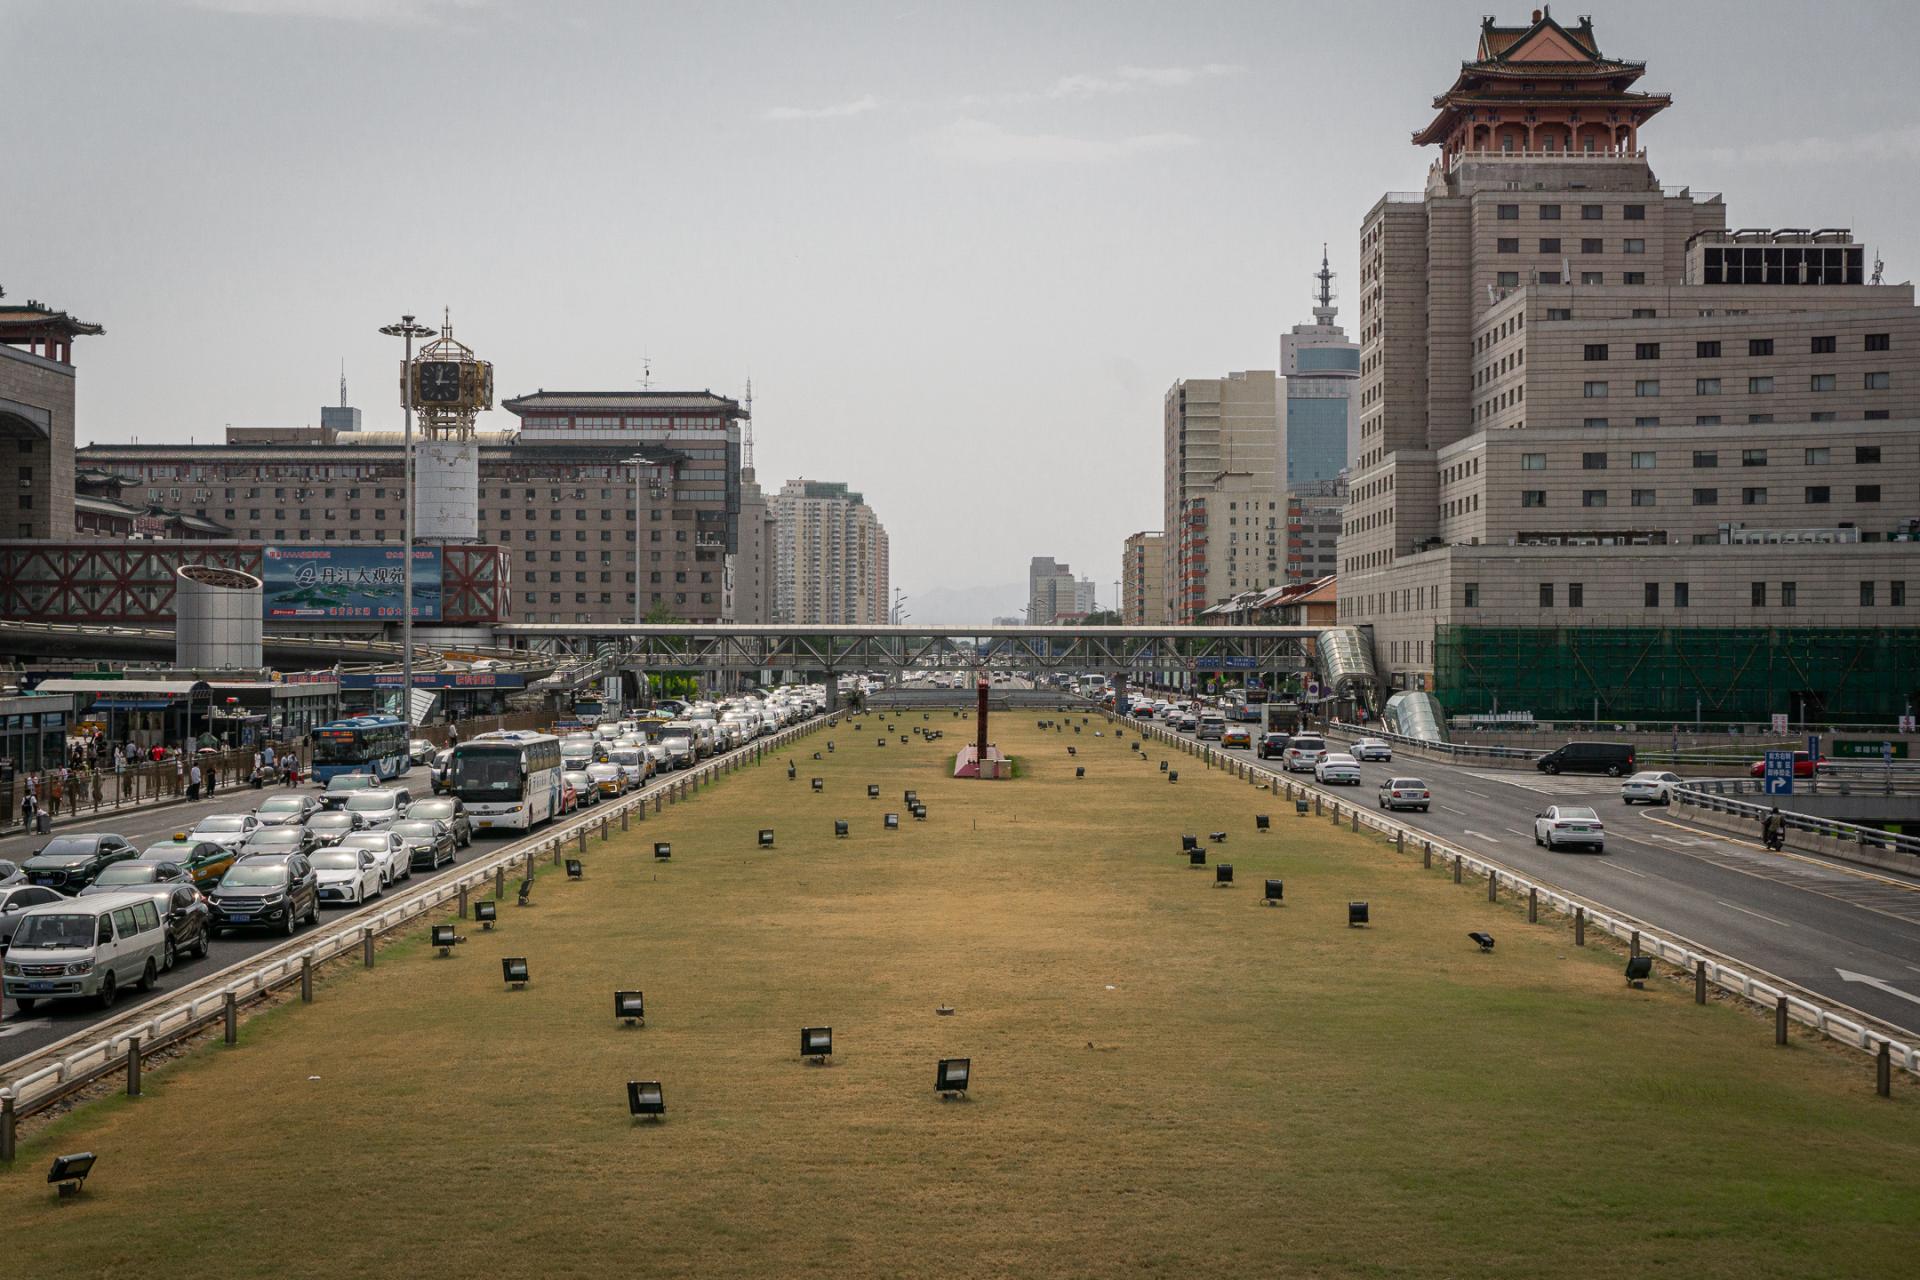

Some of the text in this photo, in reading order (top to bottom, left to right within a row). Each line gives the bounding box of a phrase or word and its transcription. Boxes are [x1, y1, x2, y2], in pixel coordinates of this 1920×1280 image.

[320, 566, 406, 585] 丹江大观苑
